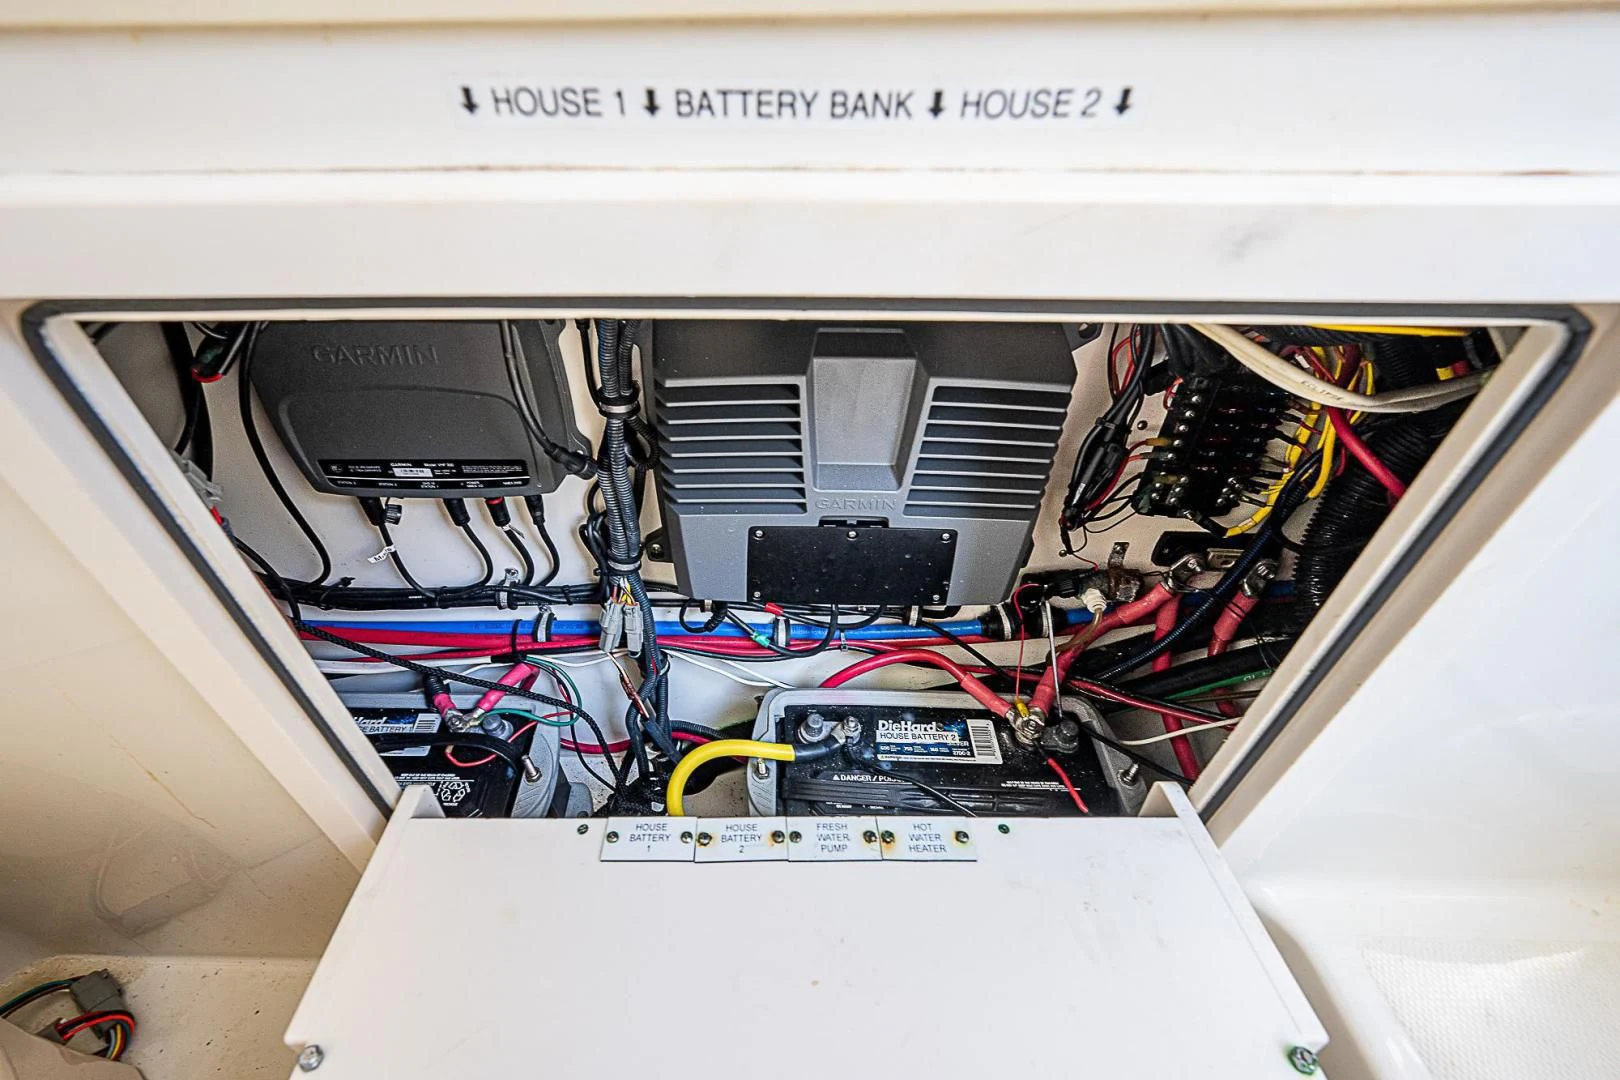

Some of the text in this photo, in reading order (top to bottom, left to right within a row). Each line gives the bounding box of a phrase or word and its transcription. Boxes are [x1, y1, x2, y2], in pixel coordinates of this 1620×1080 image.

[491, 87, 1103, 119] HOUSE 1 BATTERY BANK HOUSE 2
[312, 344, 439, 368] GARMIN
[815, 497, 897, 511] GARMIN
[878, 720, 937, 732] DieHard
[880, 732, 909, 740] HOUSE
[911, 733, 949, 741] BATTERY
[636, 823, 668, 831] HOUSE
[726, 824, 758, 832] HOUSE
[816, 823, 848, 831] FRESH
[913, 823, 933, 831] HOT
[629, 834, 672, 842] BATTERY
[721, 834, 762, 843] BATTERY
[817, 834, 850, 842] WATER
[909, 834, 942, 842] WATER
[739, 845, 745, 853] 2
[821, 845, 848, 853] PUMP
[909, 845, 947, 853] HEATER
